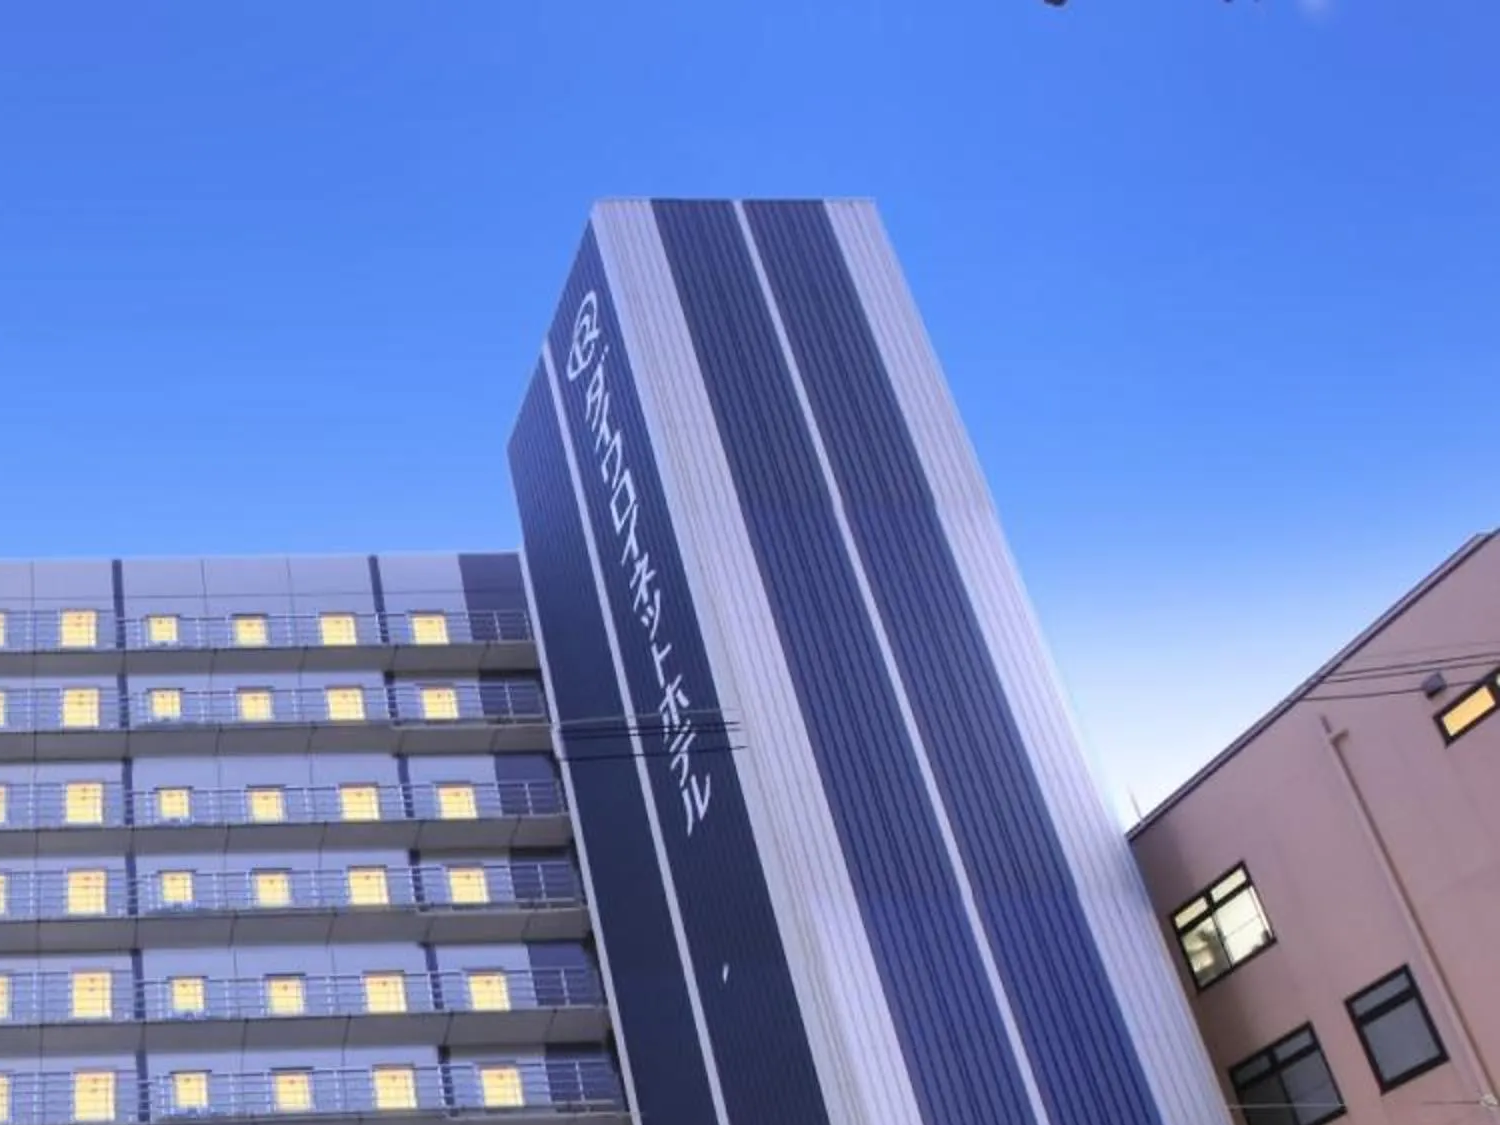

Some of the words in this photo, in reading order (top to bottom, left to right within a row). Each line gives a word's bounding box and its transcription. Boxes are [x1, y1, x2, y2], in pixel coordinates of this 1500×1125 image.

[585, 344, 712, 838] ダイワロイネットホテル
